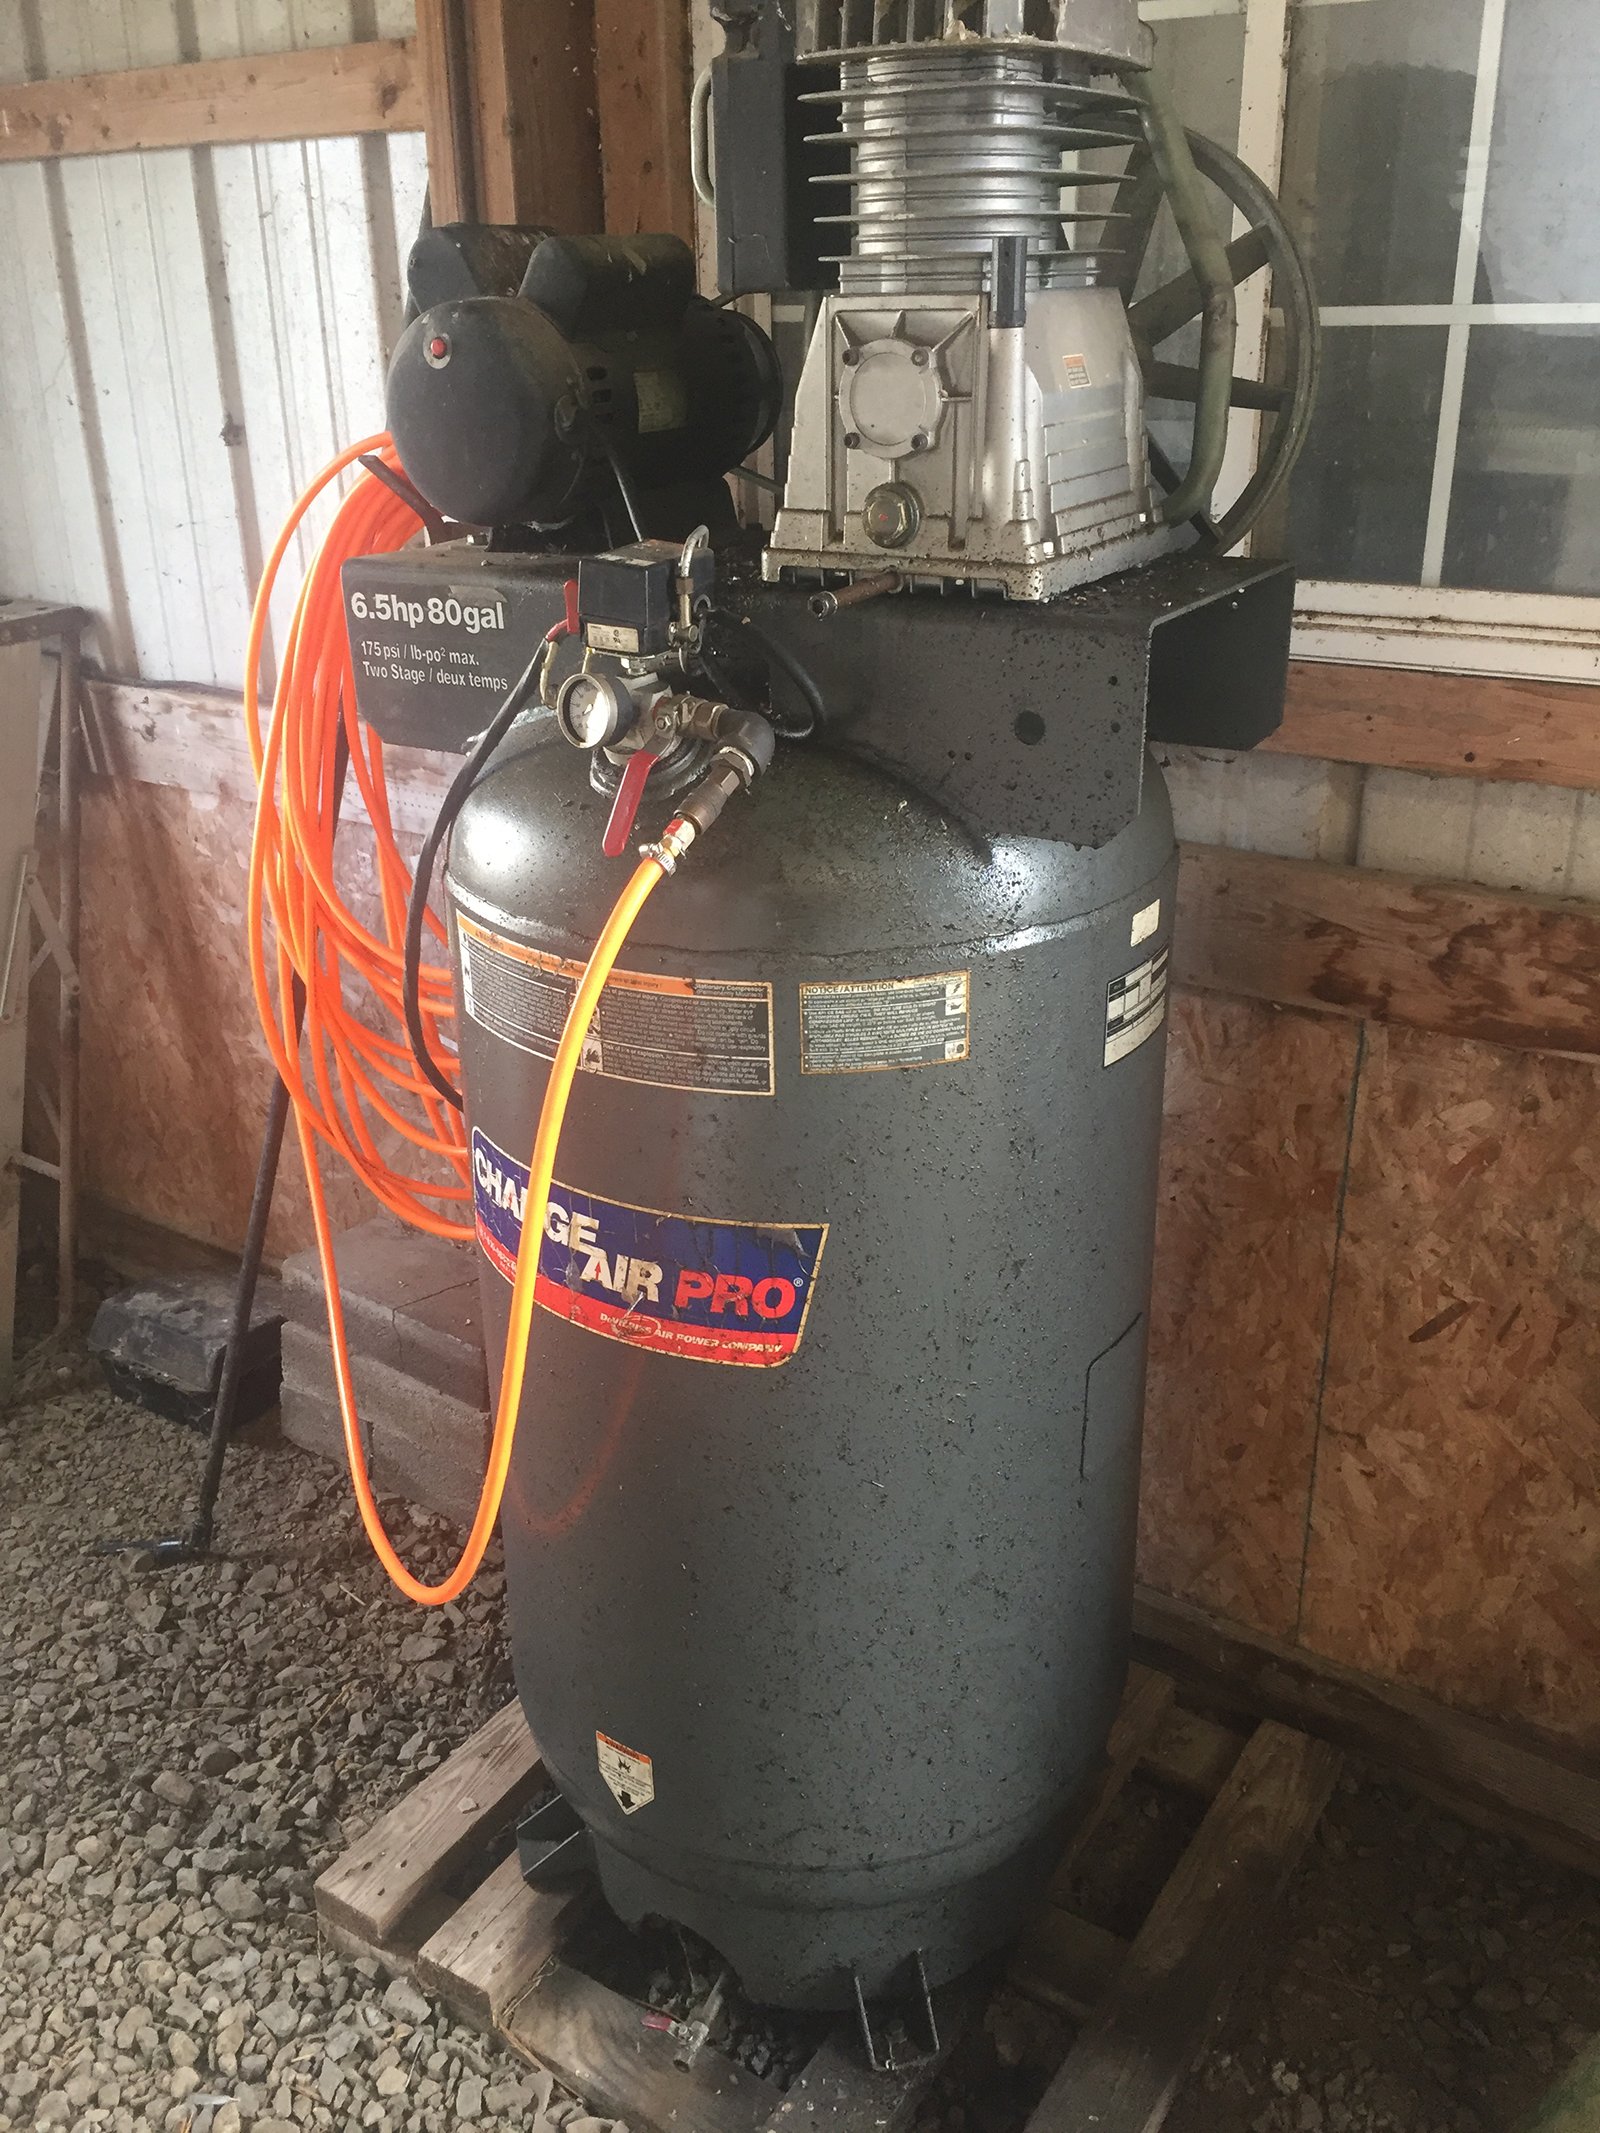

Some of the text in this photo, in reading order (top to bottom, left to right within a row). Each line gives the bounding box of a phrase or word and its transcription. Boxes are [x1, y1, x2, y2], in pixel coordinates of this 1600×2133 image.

[351, 592, 505, 634] 6.5hp 80gal
[361, 640, 382, 657] 175
[383, 642, 400, 660] psi
[449, 650, 480, 666] max.
[362, 661, 388, 679] Two
[391, 663, 425, 685] Stage
[436, 669, 466, 686] deux
[468, 673, 508, 692] temps
[475, 1148, 599, 1255] CHAGE
[581, 1247, 663, 1303] AIR
[654, 1329, 674, 1340] AIR
[676, 1333, 720, 1347] POWER
[722, 1340, 783, 1353] COMPANY
